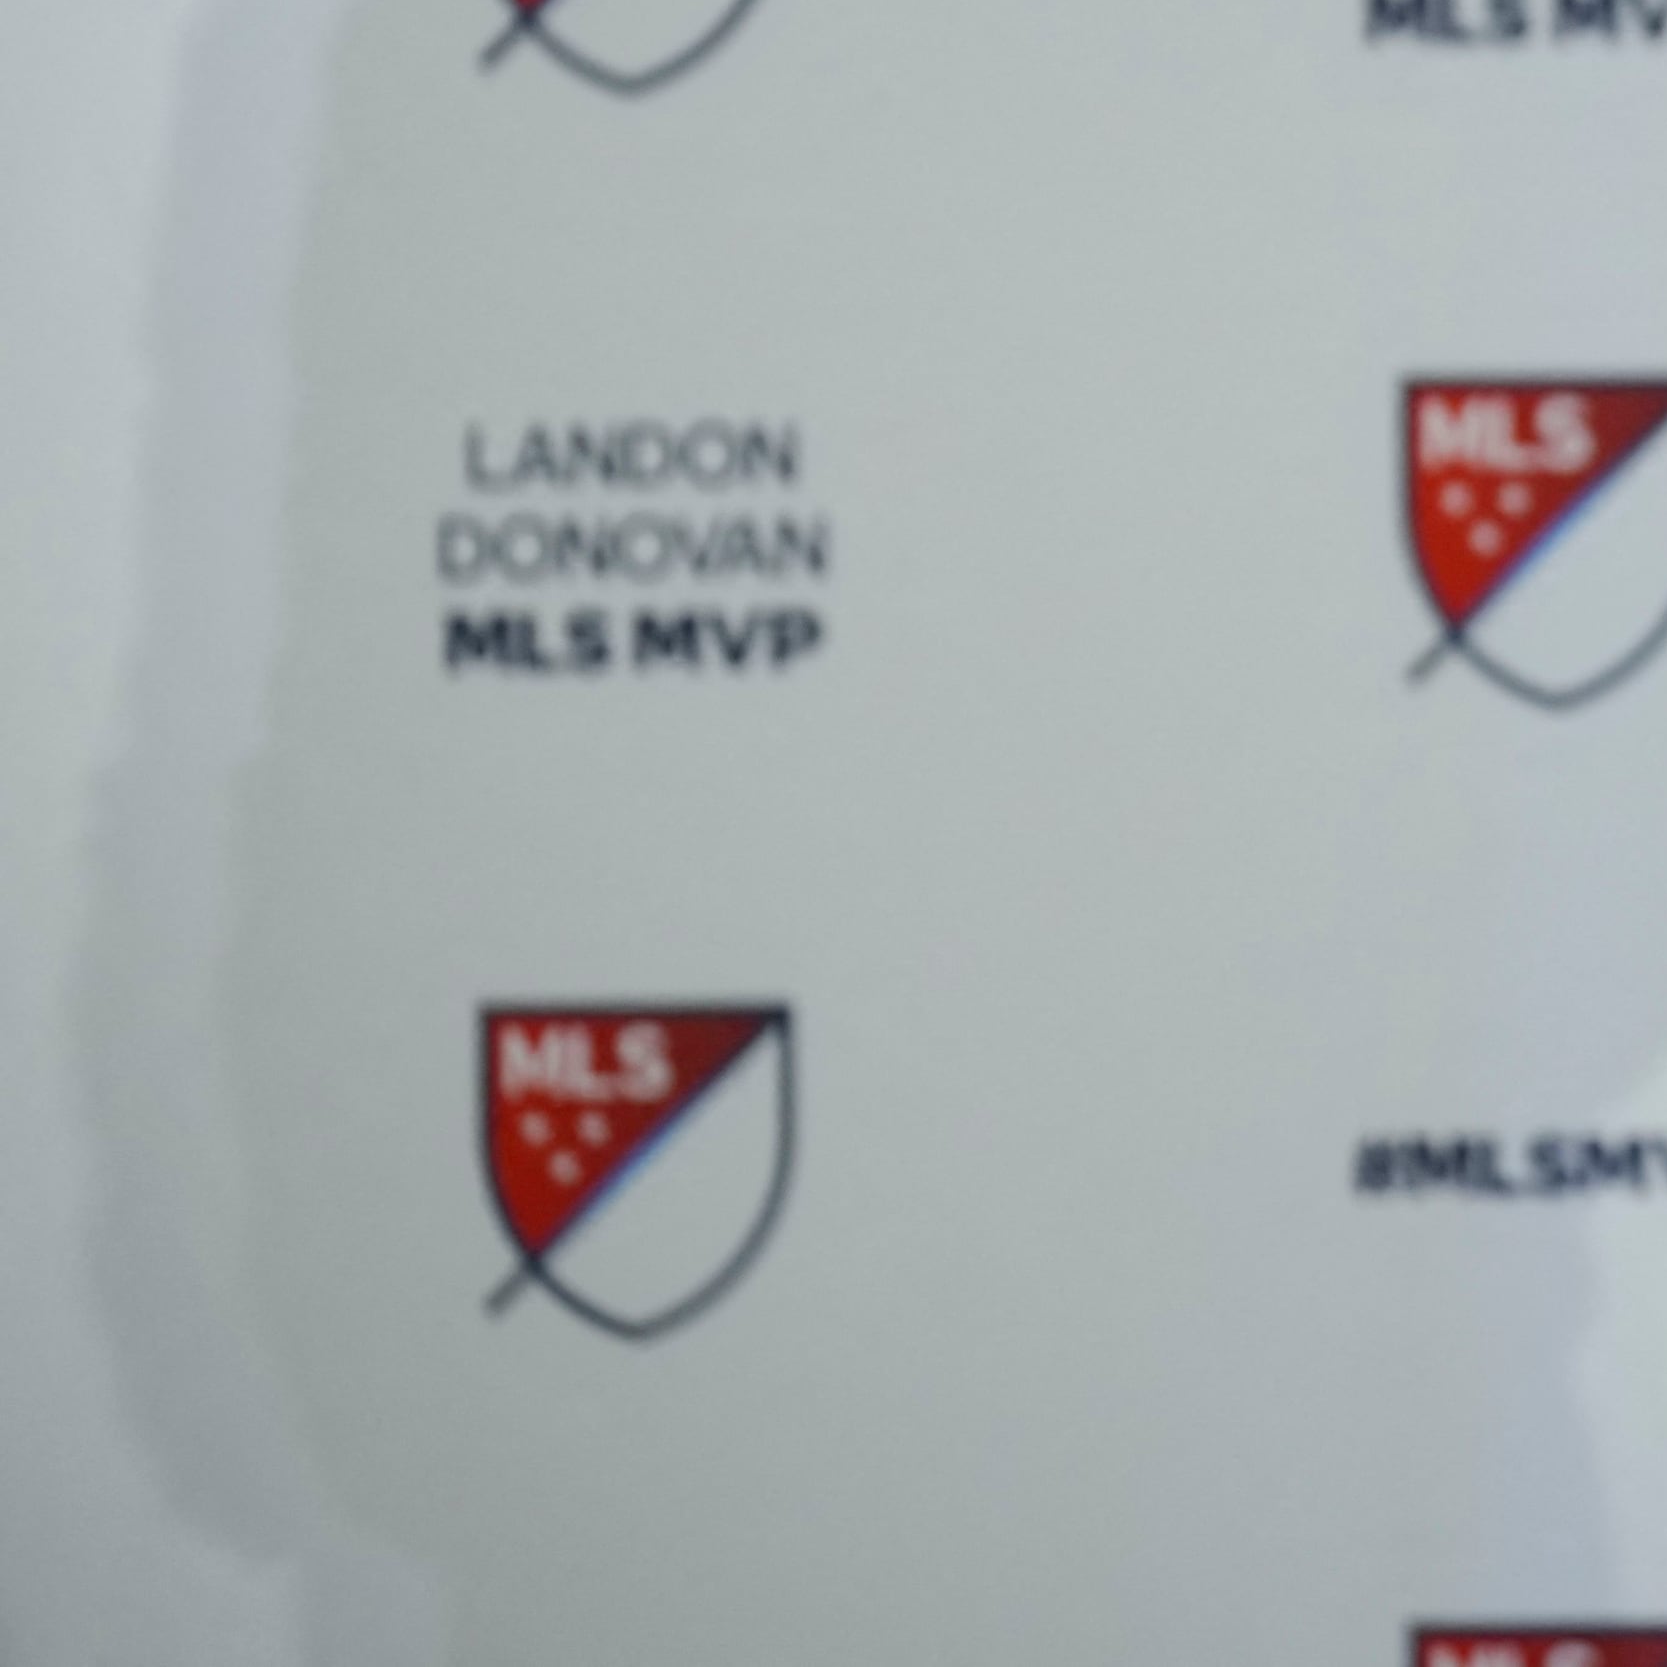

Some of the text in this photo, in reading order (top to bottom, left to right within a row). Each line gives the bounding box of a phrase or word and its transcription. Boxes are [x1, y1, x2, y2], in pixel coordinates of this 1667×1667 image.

[463, 420, 800, 491] LANDON
[1418, 391, 1597, 474] MLS
[435, 510, 830, 584] DONOVAN
[445, 607, 823, 676] MLS MVP
[500, 1022, 675, 1102] MLS
